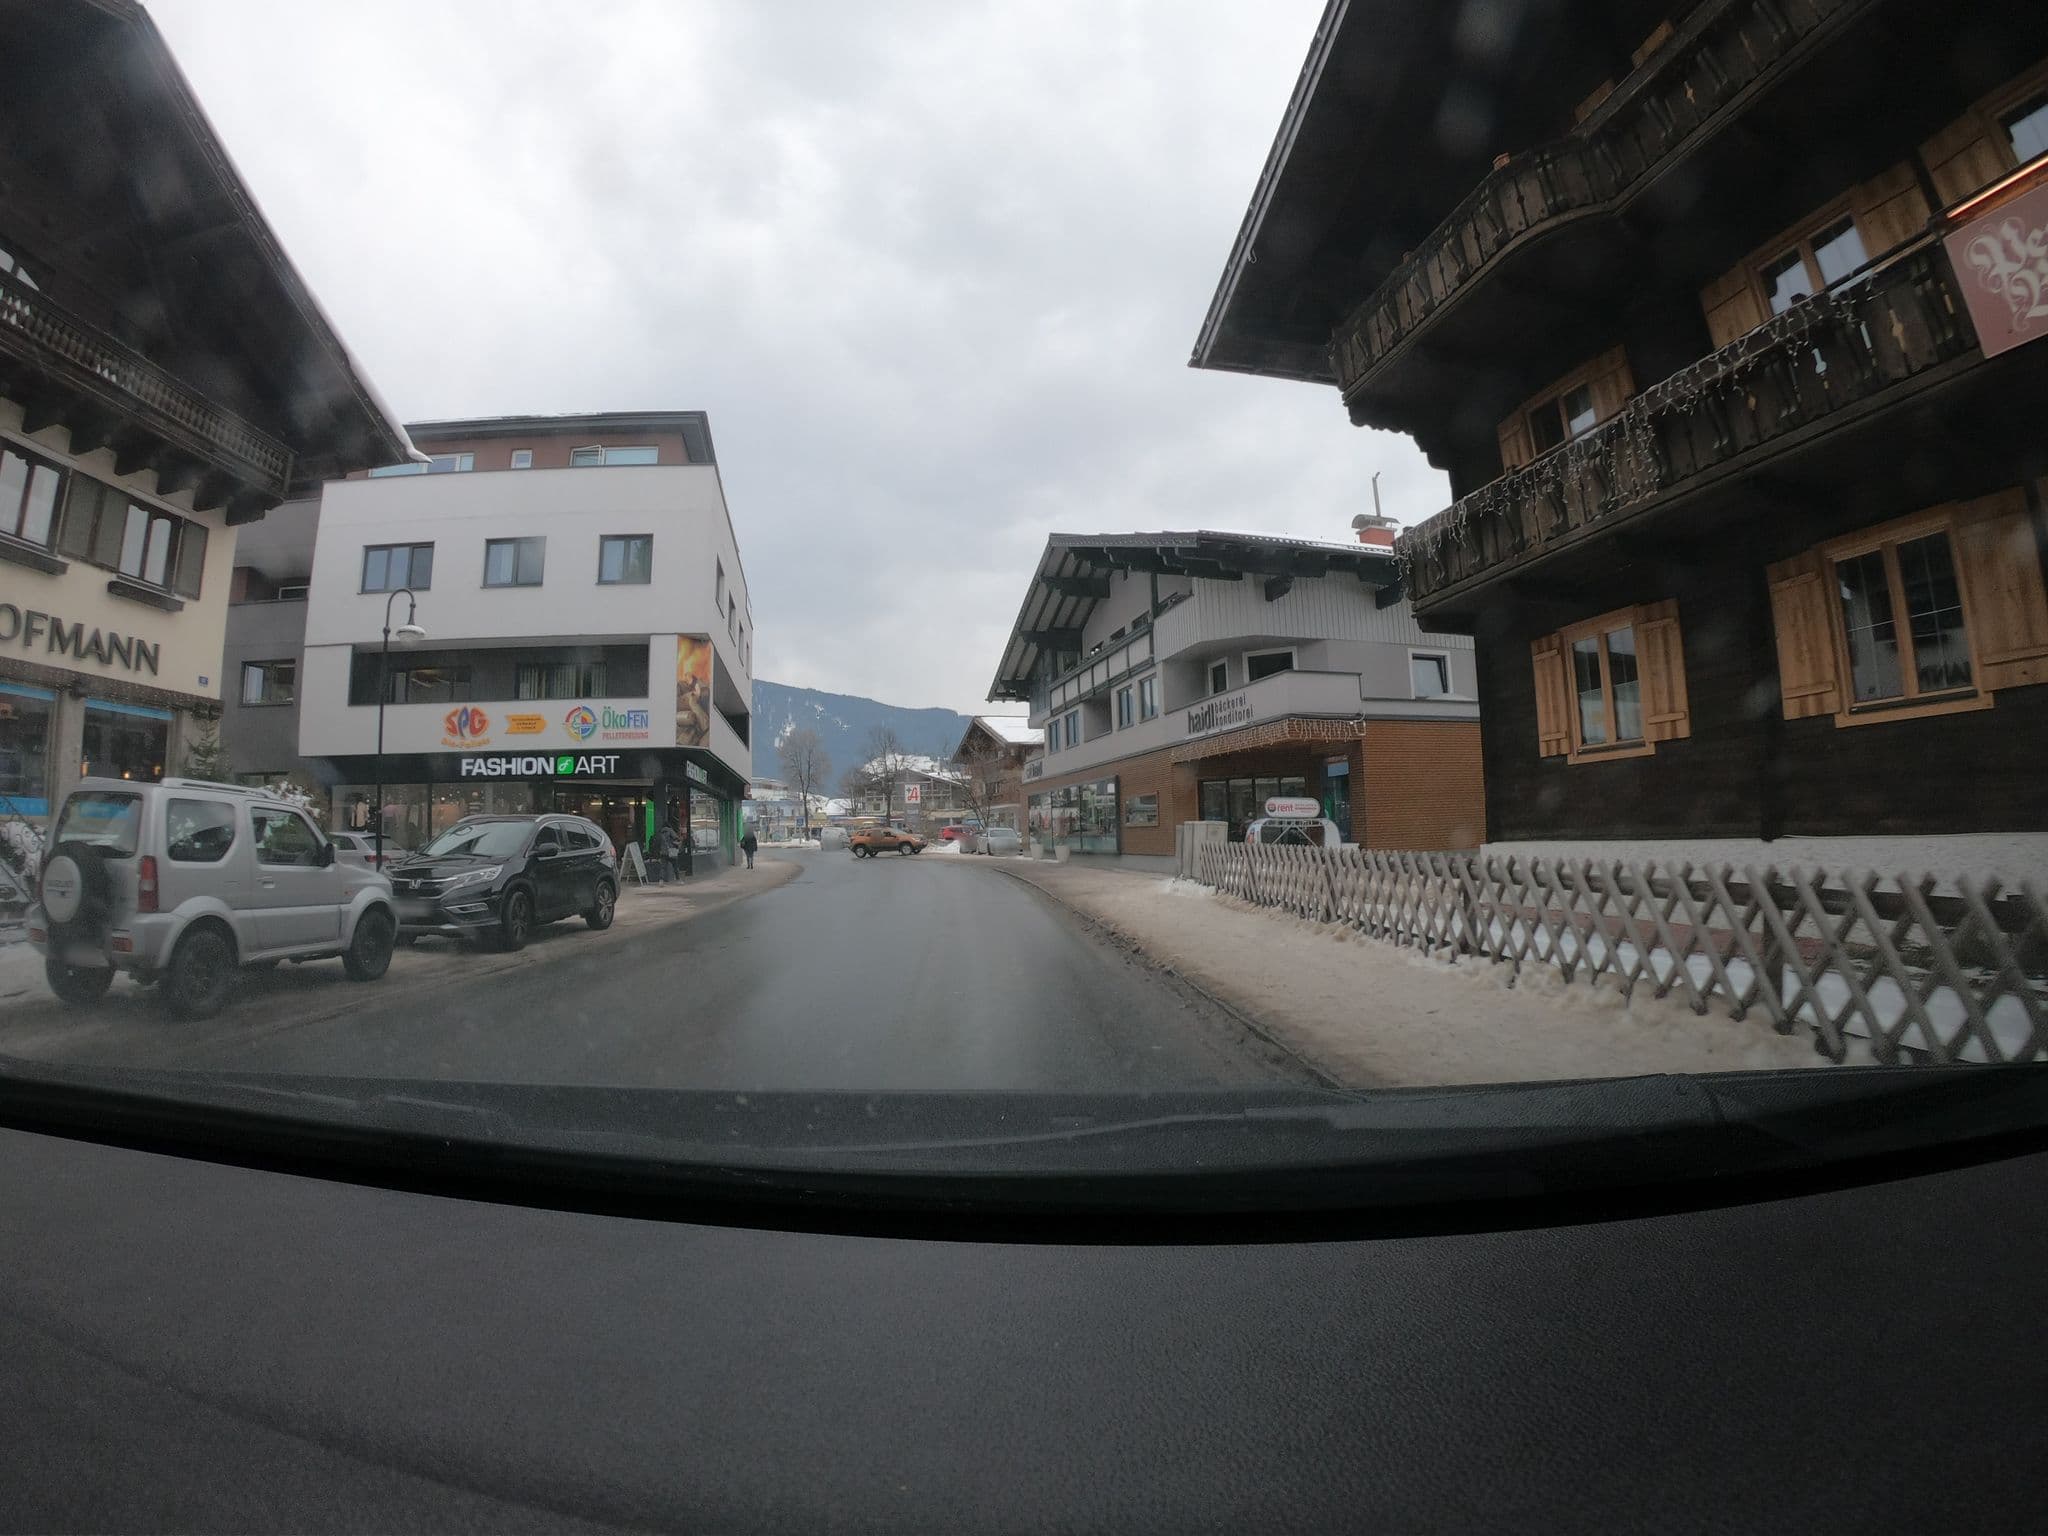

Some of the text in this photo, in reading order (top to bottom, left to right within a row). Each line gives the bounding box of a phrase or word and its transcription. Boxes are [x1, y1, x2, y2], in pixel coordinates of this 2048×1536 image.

[0, 603, 160, 676] OFMANN
[602, 706, 649, 729] ÖkoFEN
[1187, 703, 1215, 734] haidl
[461, 757, 555, 776] FASHION
[574, 756, 620, 774] ART
[1277, 804, 1294, 812] rent
